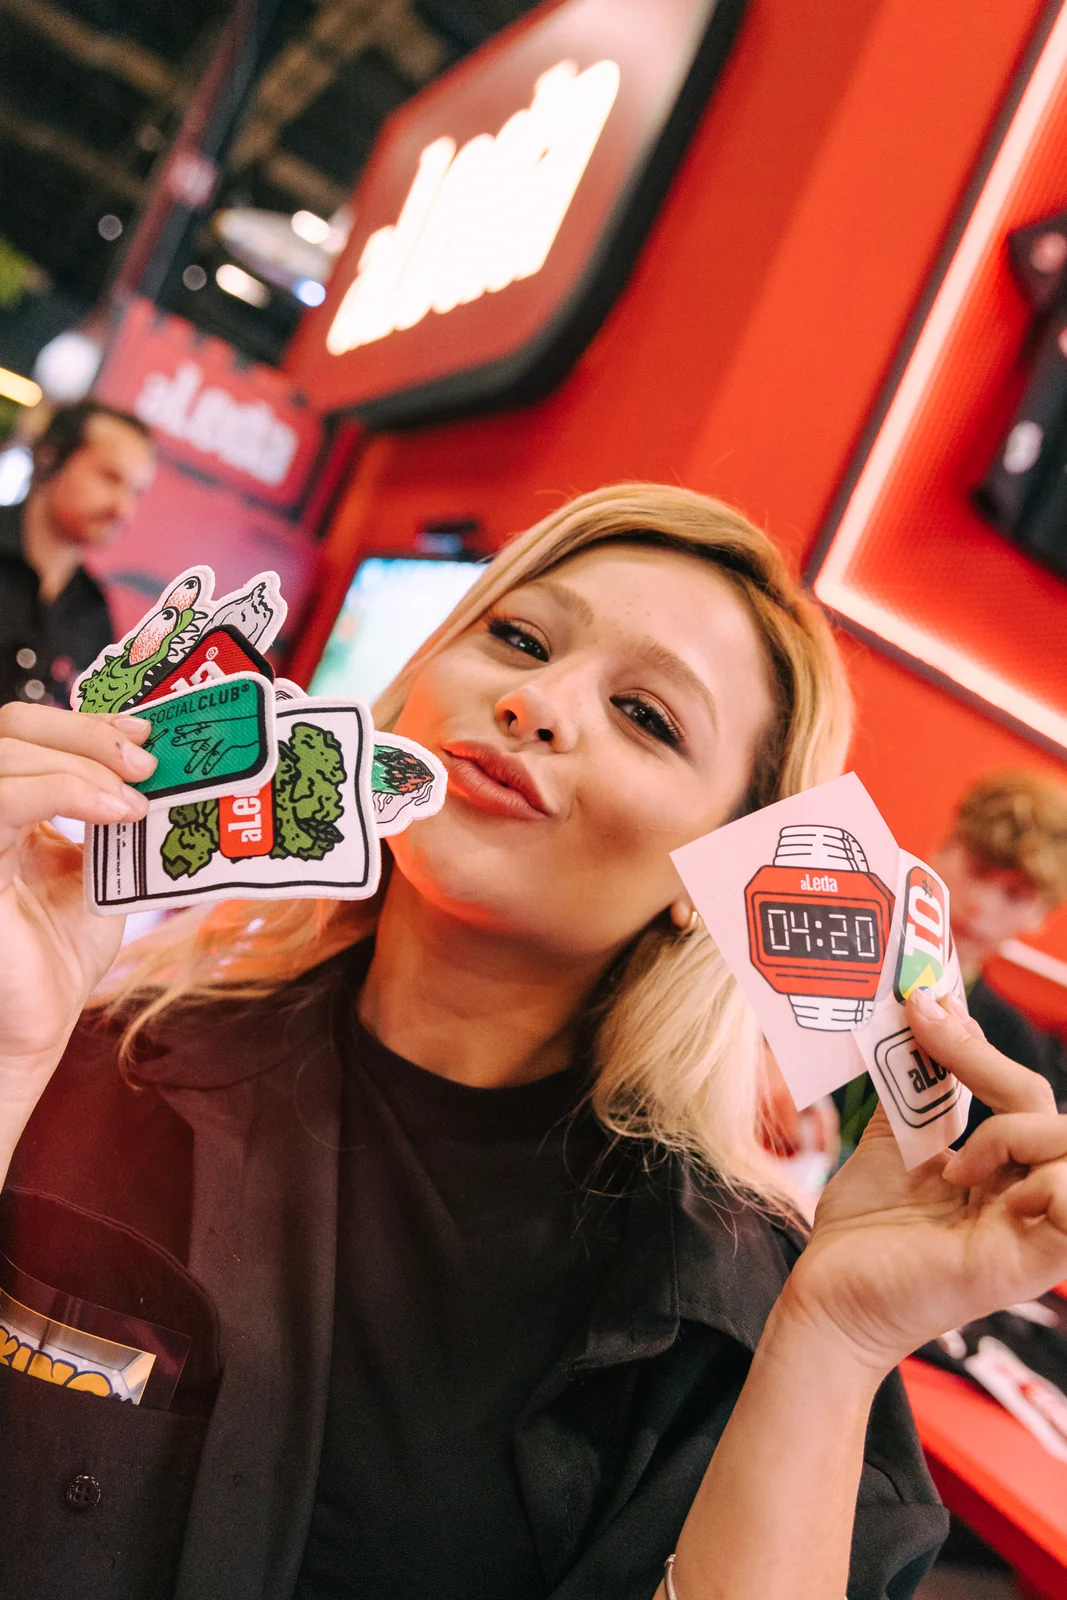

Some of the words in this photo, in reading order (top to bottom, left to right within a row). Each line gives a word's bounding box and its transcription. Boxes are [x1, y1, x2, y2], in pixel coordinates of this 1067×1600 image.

[228, 796, 263, 843] aLe
[800, 873, 838, 893] aLeda
[767, 909, 875, 958] 04:20
[908, 1050, 951, 1094] aLe
